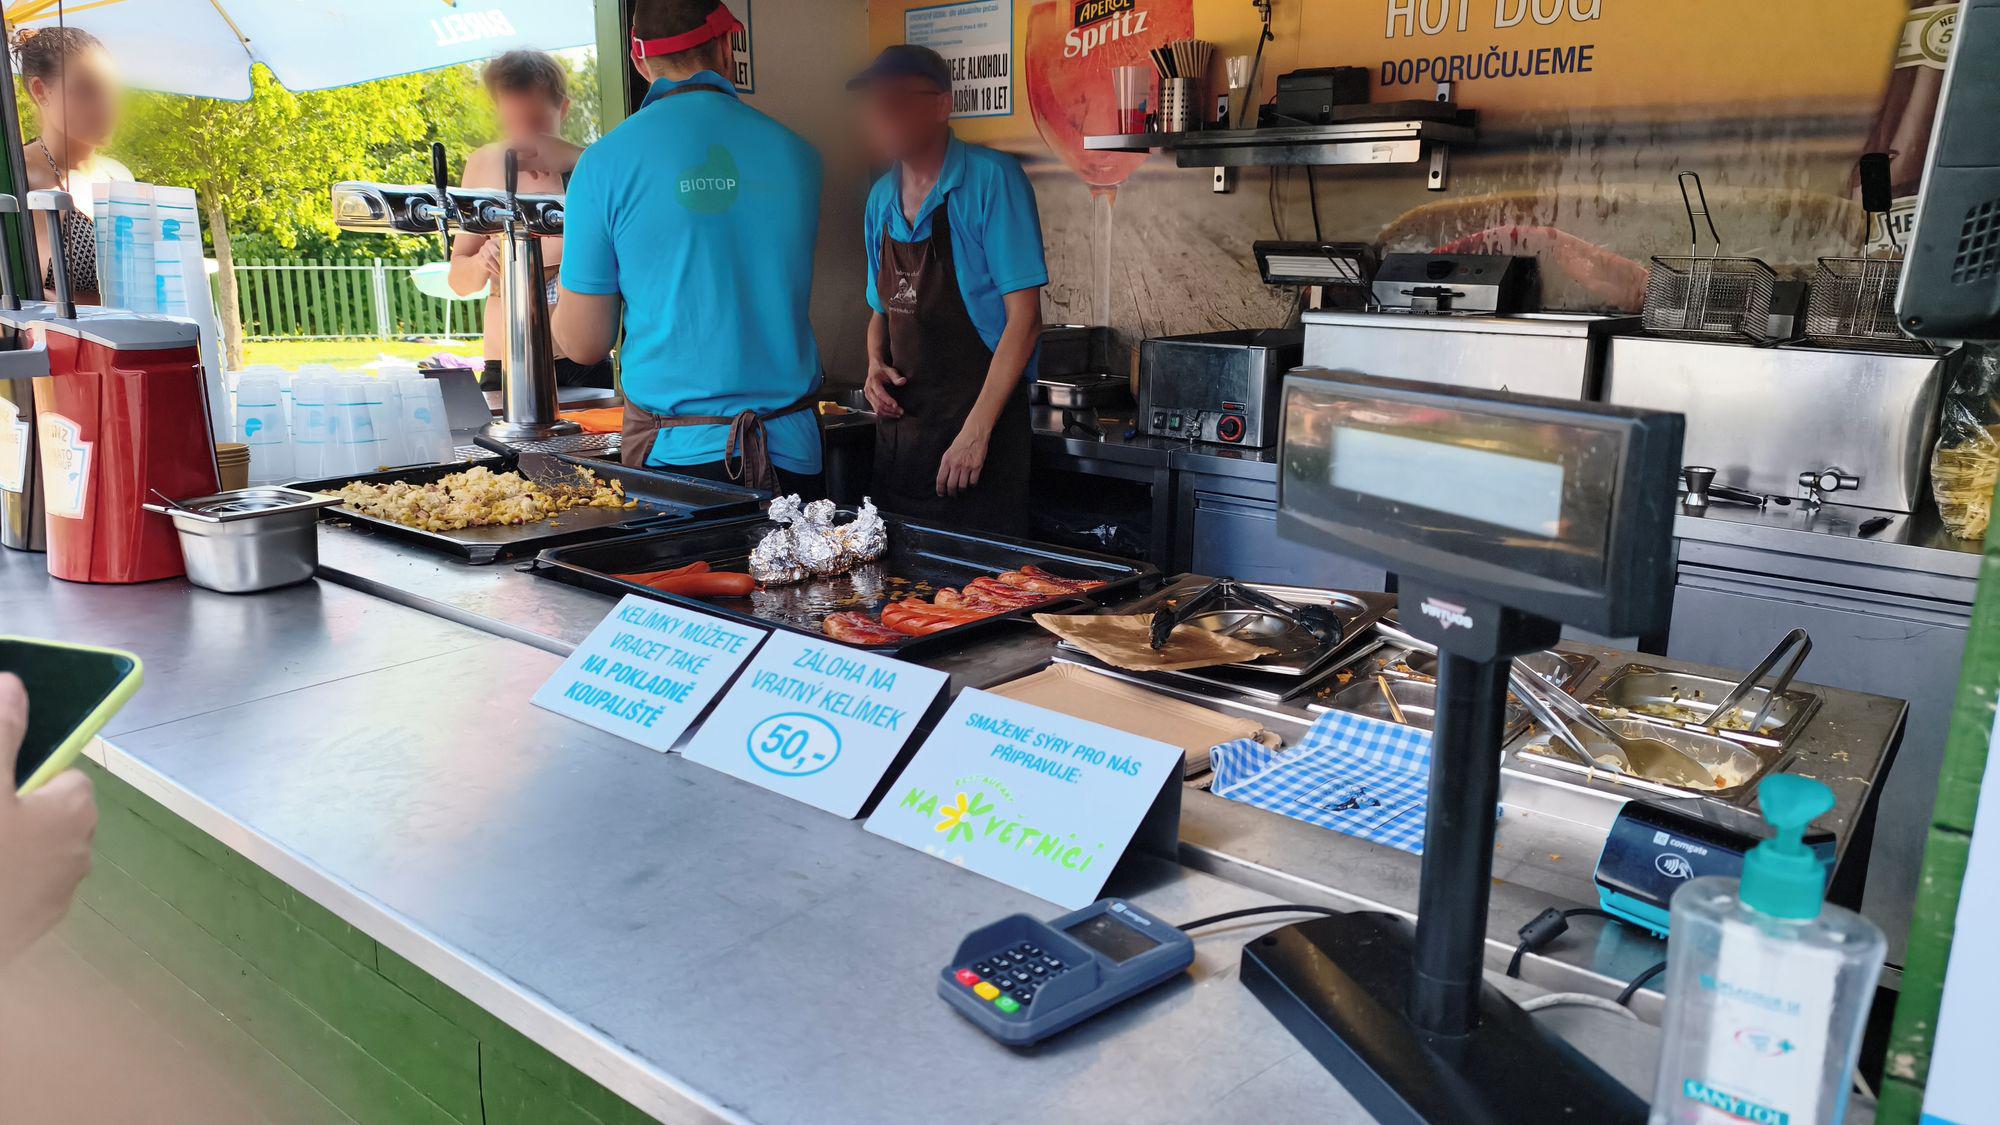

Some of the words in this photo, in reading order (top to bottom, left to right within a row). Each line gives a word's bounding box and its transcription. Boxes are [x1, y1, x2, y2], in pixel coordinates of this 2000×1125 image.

[1064, 10, 1148, 58] Spritz
[735, 61, 748, 86] LET
[967, 53, 1009, 80] ALKOHOLU
[1381, 45, 1595, 87] DOPORUČUJEME
[952, 85, 979, 113] ADŠÍM
[981, 87, 992, 111] 18
[994, 86, 1008, 110] LET
[680, 178, 736, 193] BIOTOP
[616, 604, 685, 634] KELÍMKY
[679, 621, 748, 654] MŮŽETE
[609, 631, 670, 661] VRACET
[666, 648, 713, 676] TAKÉ
[793, 648, 866, 684] ZÁLOHA
[866, 667, 898, 693] NA
[580, 653, 608, 676] NA
[604, 660, 697, 704] POKLADNĚ
[751, 668, 825, 705] VRATNÝ
[818, 689, 908, 732] KELÍMEK
[564, 680, 667, 729] KOUPALIŠTĚ
[761, 723, 826, 770] 50,-
[965, 712, 1035, 744] SMAŽENÉ
[1032, 731, 1075, 755] SÝRY
[1072, 744, 1107, 766] PRO
[1106, 754, 1142, 777] NÁS
[990, 743, 1083, 784] PŘIPRAVUJE:
[899, 787, 939, 819] NA
[1669, 838, 1708, 857] comgate
